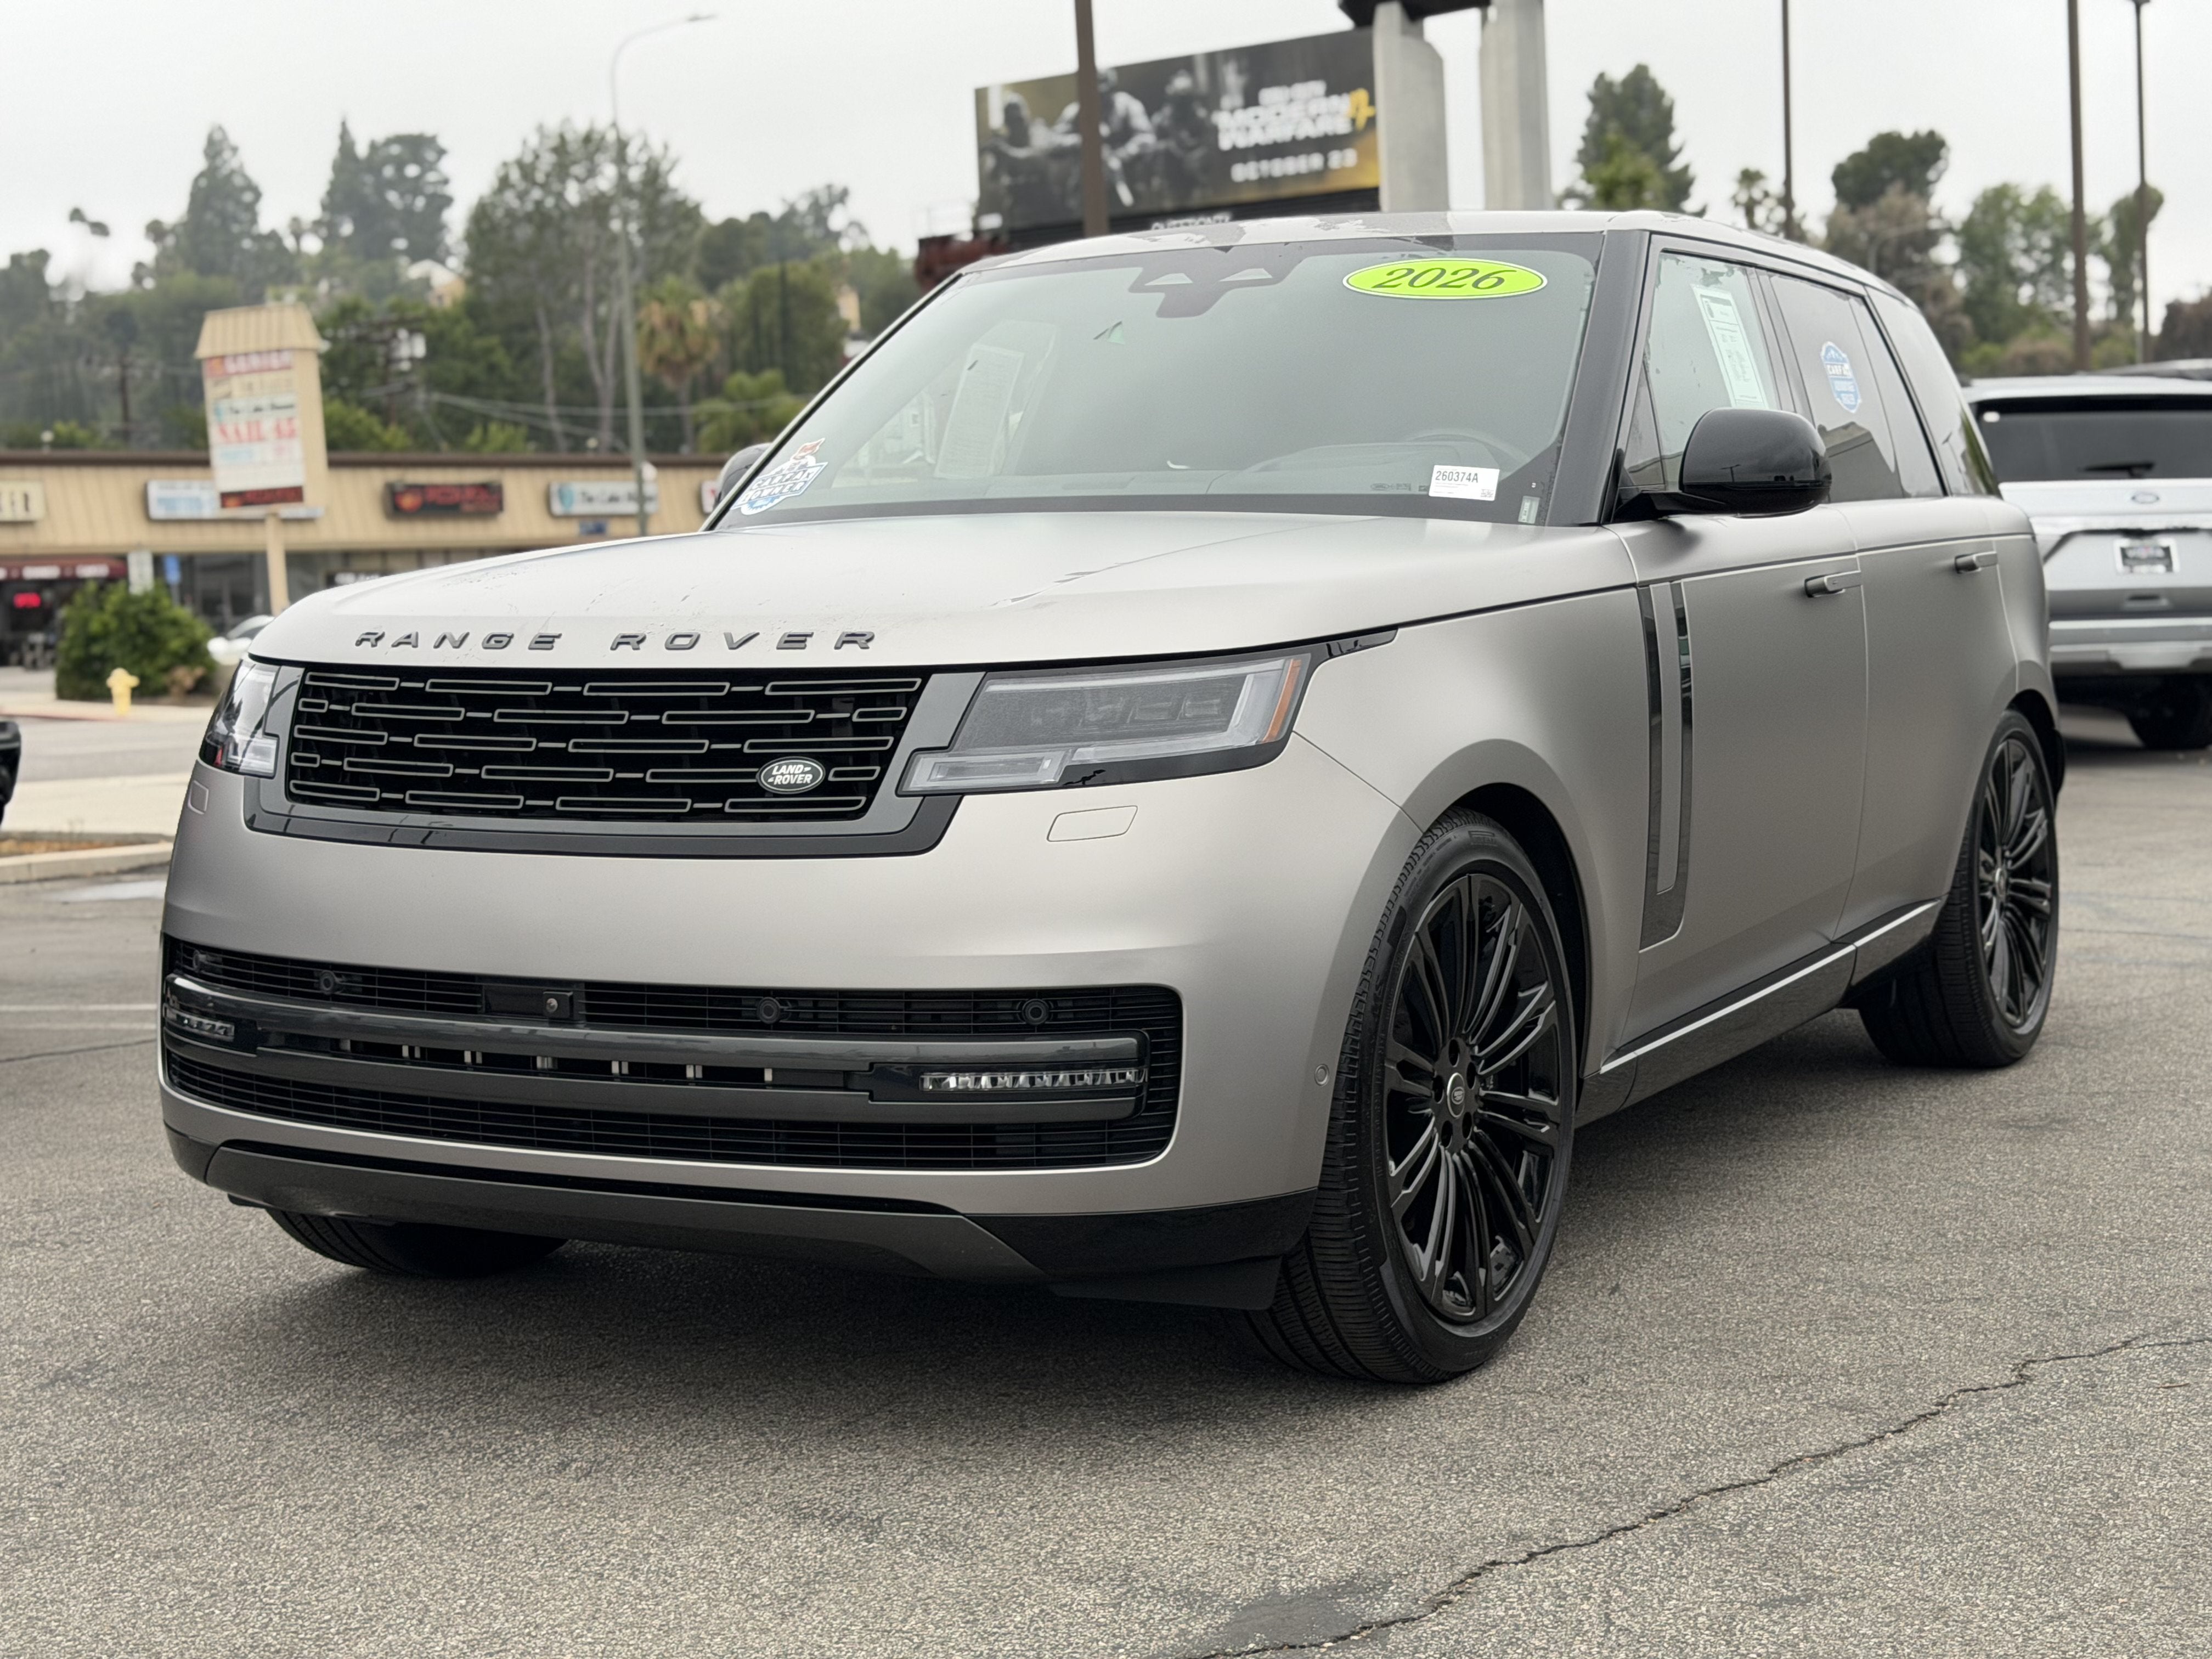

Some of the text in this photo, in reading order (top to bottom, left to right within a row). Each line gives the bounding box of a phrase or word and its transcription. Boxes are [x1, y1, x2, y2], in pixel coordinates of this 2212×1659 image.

[1231, 152, 1324, 182] OCTOBER
[1371, 267, 1517, 290] 2026
[752, 469, 818, 489] CARFAX
[1435, 471, 1479, 483] 260374A
[355, 631, 875, 651] RANGE ROVER
[771, 764, 804, 775] LAND
[774, 774, 812, 785] ROVER
